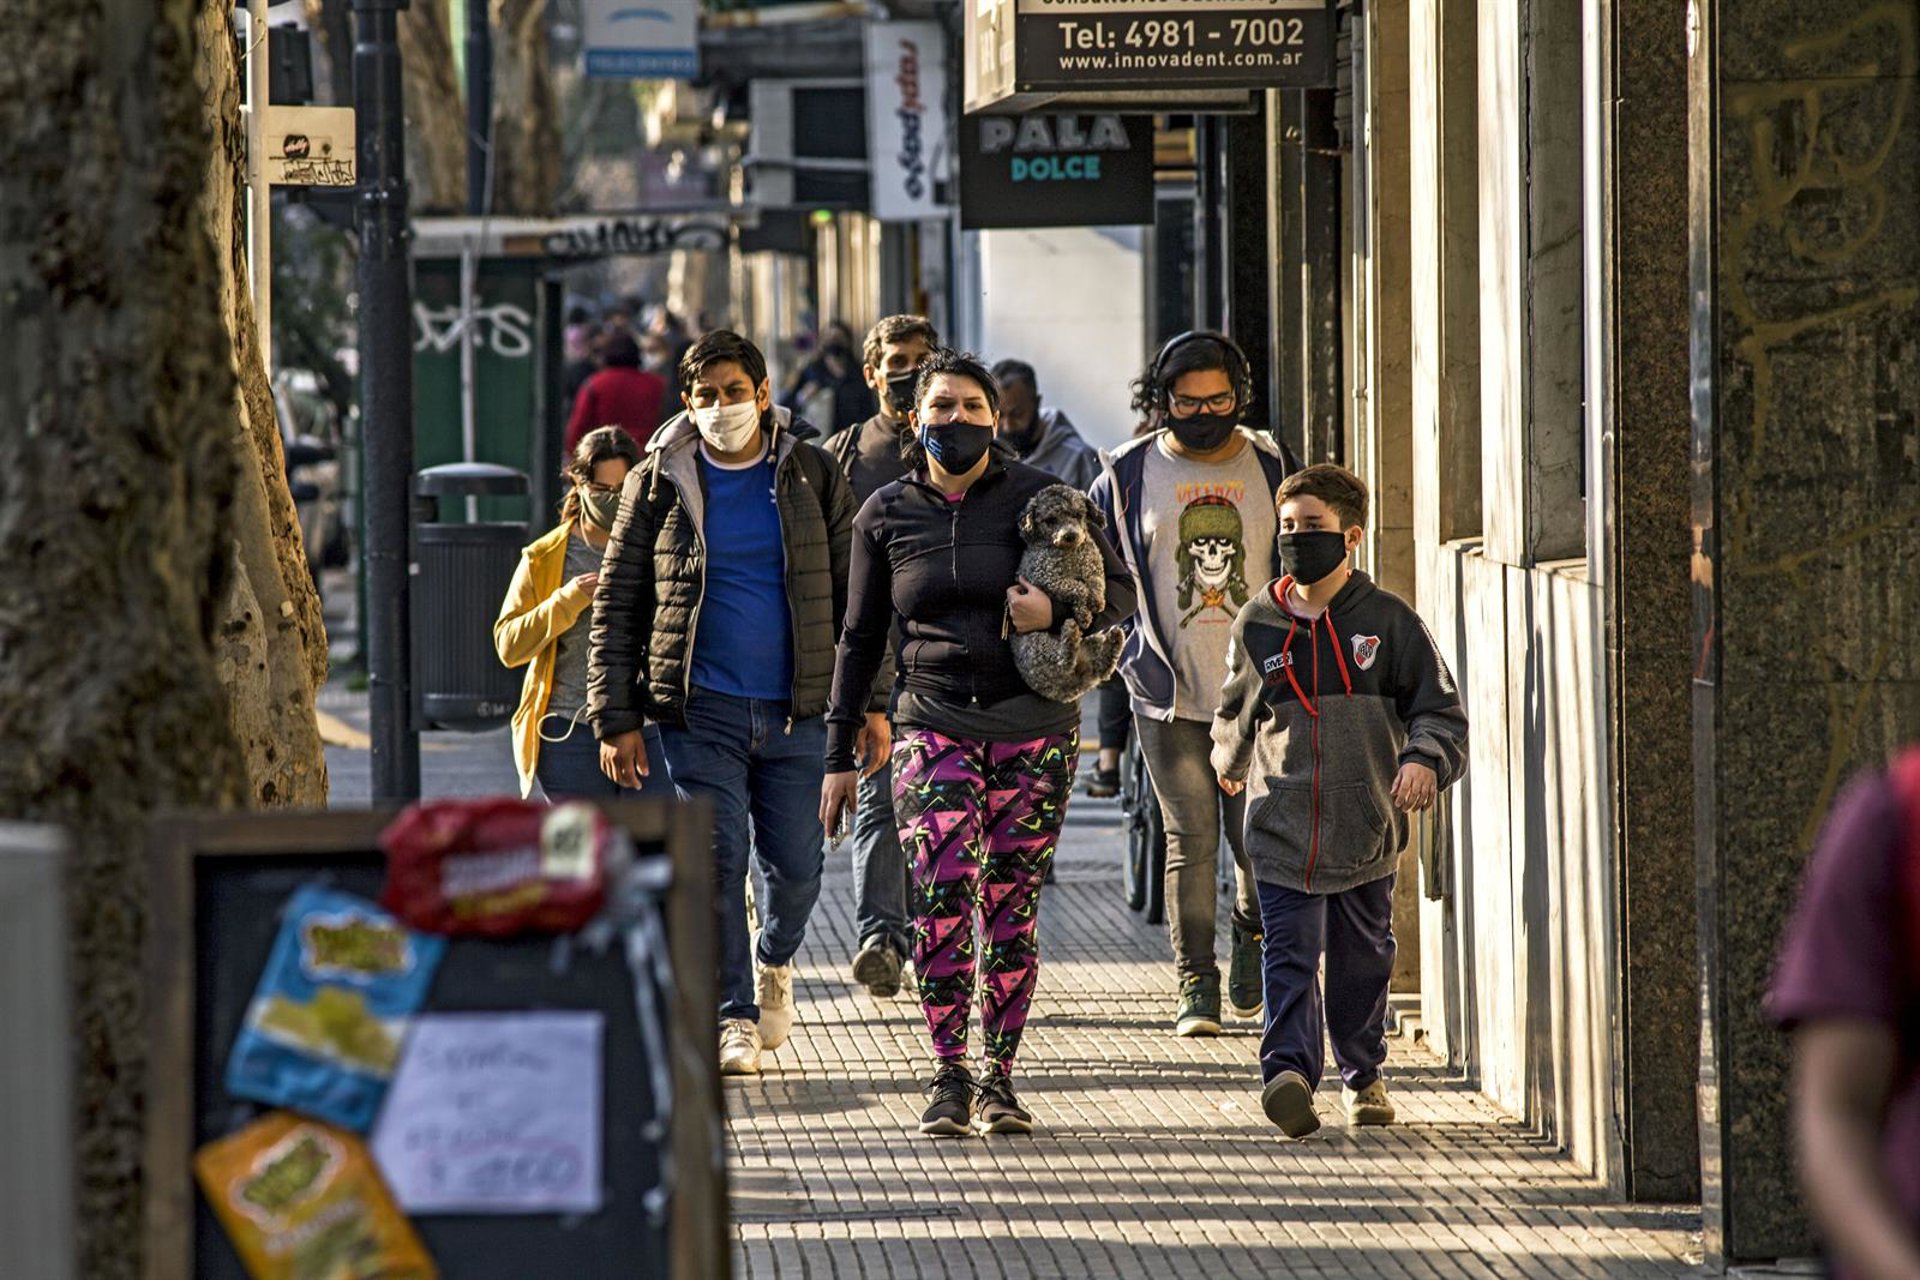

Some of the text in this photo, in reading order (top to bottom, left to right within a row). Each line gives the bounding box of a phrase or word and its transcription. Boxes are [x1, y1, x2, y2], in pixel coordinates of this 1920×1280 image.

[1058, 22, 1116, 49] Tel:
[1124, 20, 1195, 48] 4981
[1230, 18, 1304, 46] 7002
[1058, 51, 1303, 69] www.innovadent.com.ar
[979, 113, 1131, 153] PALA
[1011, 156, 1101, 182] DOLCE
